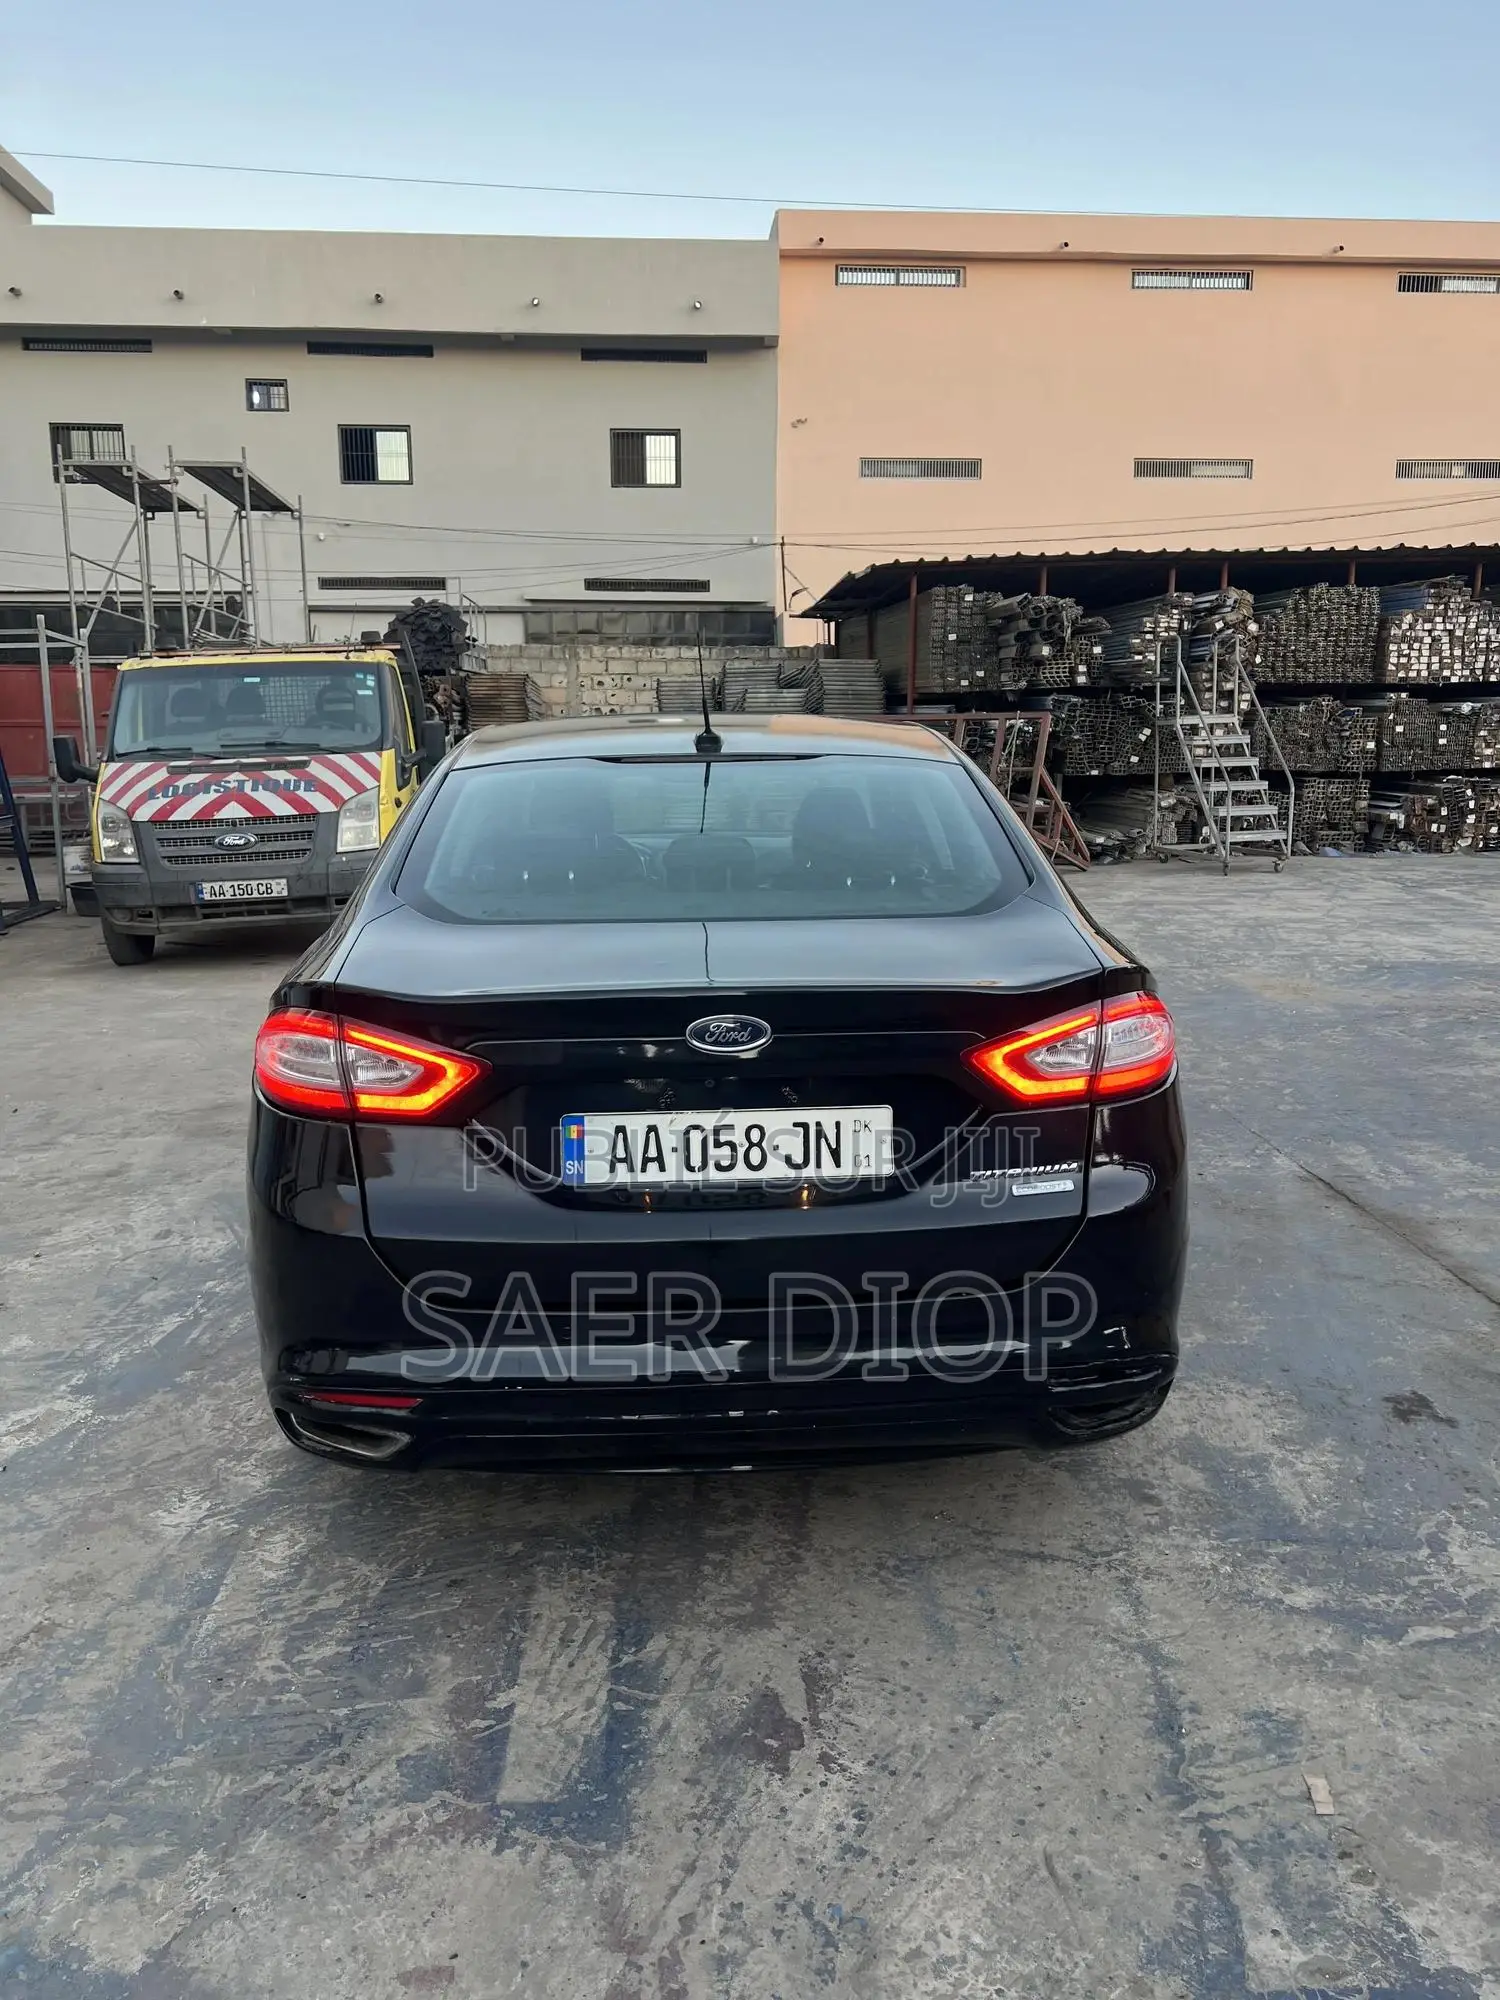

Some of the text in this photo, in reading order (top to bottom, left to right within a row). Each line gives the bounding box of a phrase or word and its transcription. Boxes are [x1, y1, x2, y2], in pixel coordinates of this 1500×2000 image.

[148, 779, 318, 800] LOGISTIQUE
[223, 836, 245, 846] Ford
[705, 1022, 752, 1043] Ford
[853, 1119, 873, 1133] DK
[565, 1161, 583, 1175] SN
[970, 1162, 1079, 1183] TITANIUM
